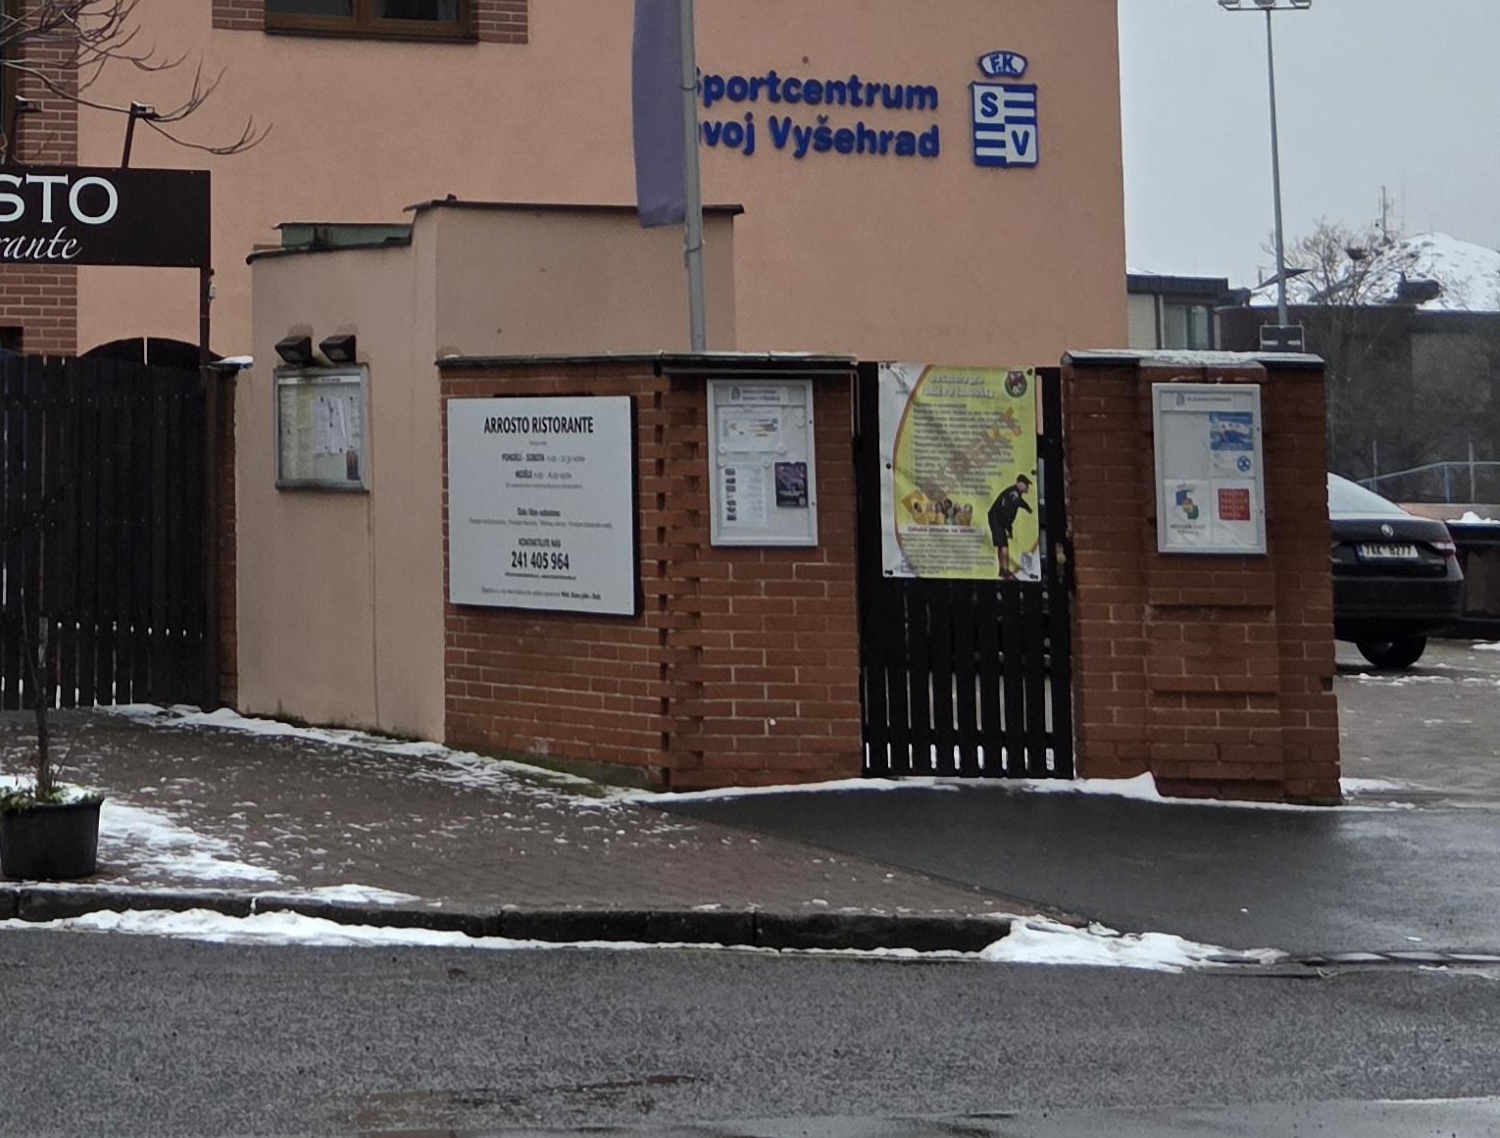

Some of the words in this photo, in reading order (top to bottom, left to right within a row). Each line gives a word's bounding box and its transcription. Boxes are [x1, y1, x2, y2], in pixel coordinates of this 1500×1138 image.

[696, 67, 938, 111] portcentrum
[980, 91, 999, 118] S
[698, 112, 755, 156] voj
[768, 114, 940, 159] Vyšehrad
[1011, 129, 1030, 157] V
[484, 416, 530, 434] ARROSTO
[532, 416, 594, 434] RISTORANTE
[511, 550, 527, 568] 241
[530, 551, 549, 570] 405
[550, 552, 569, 570] 964
